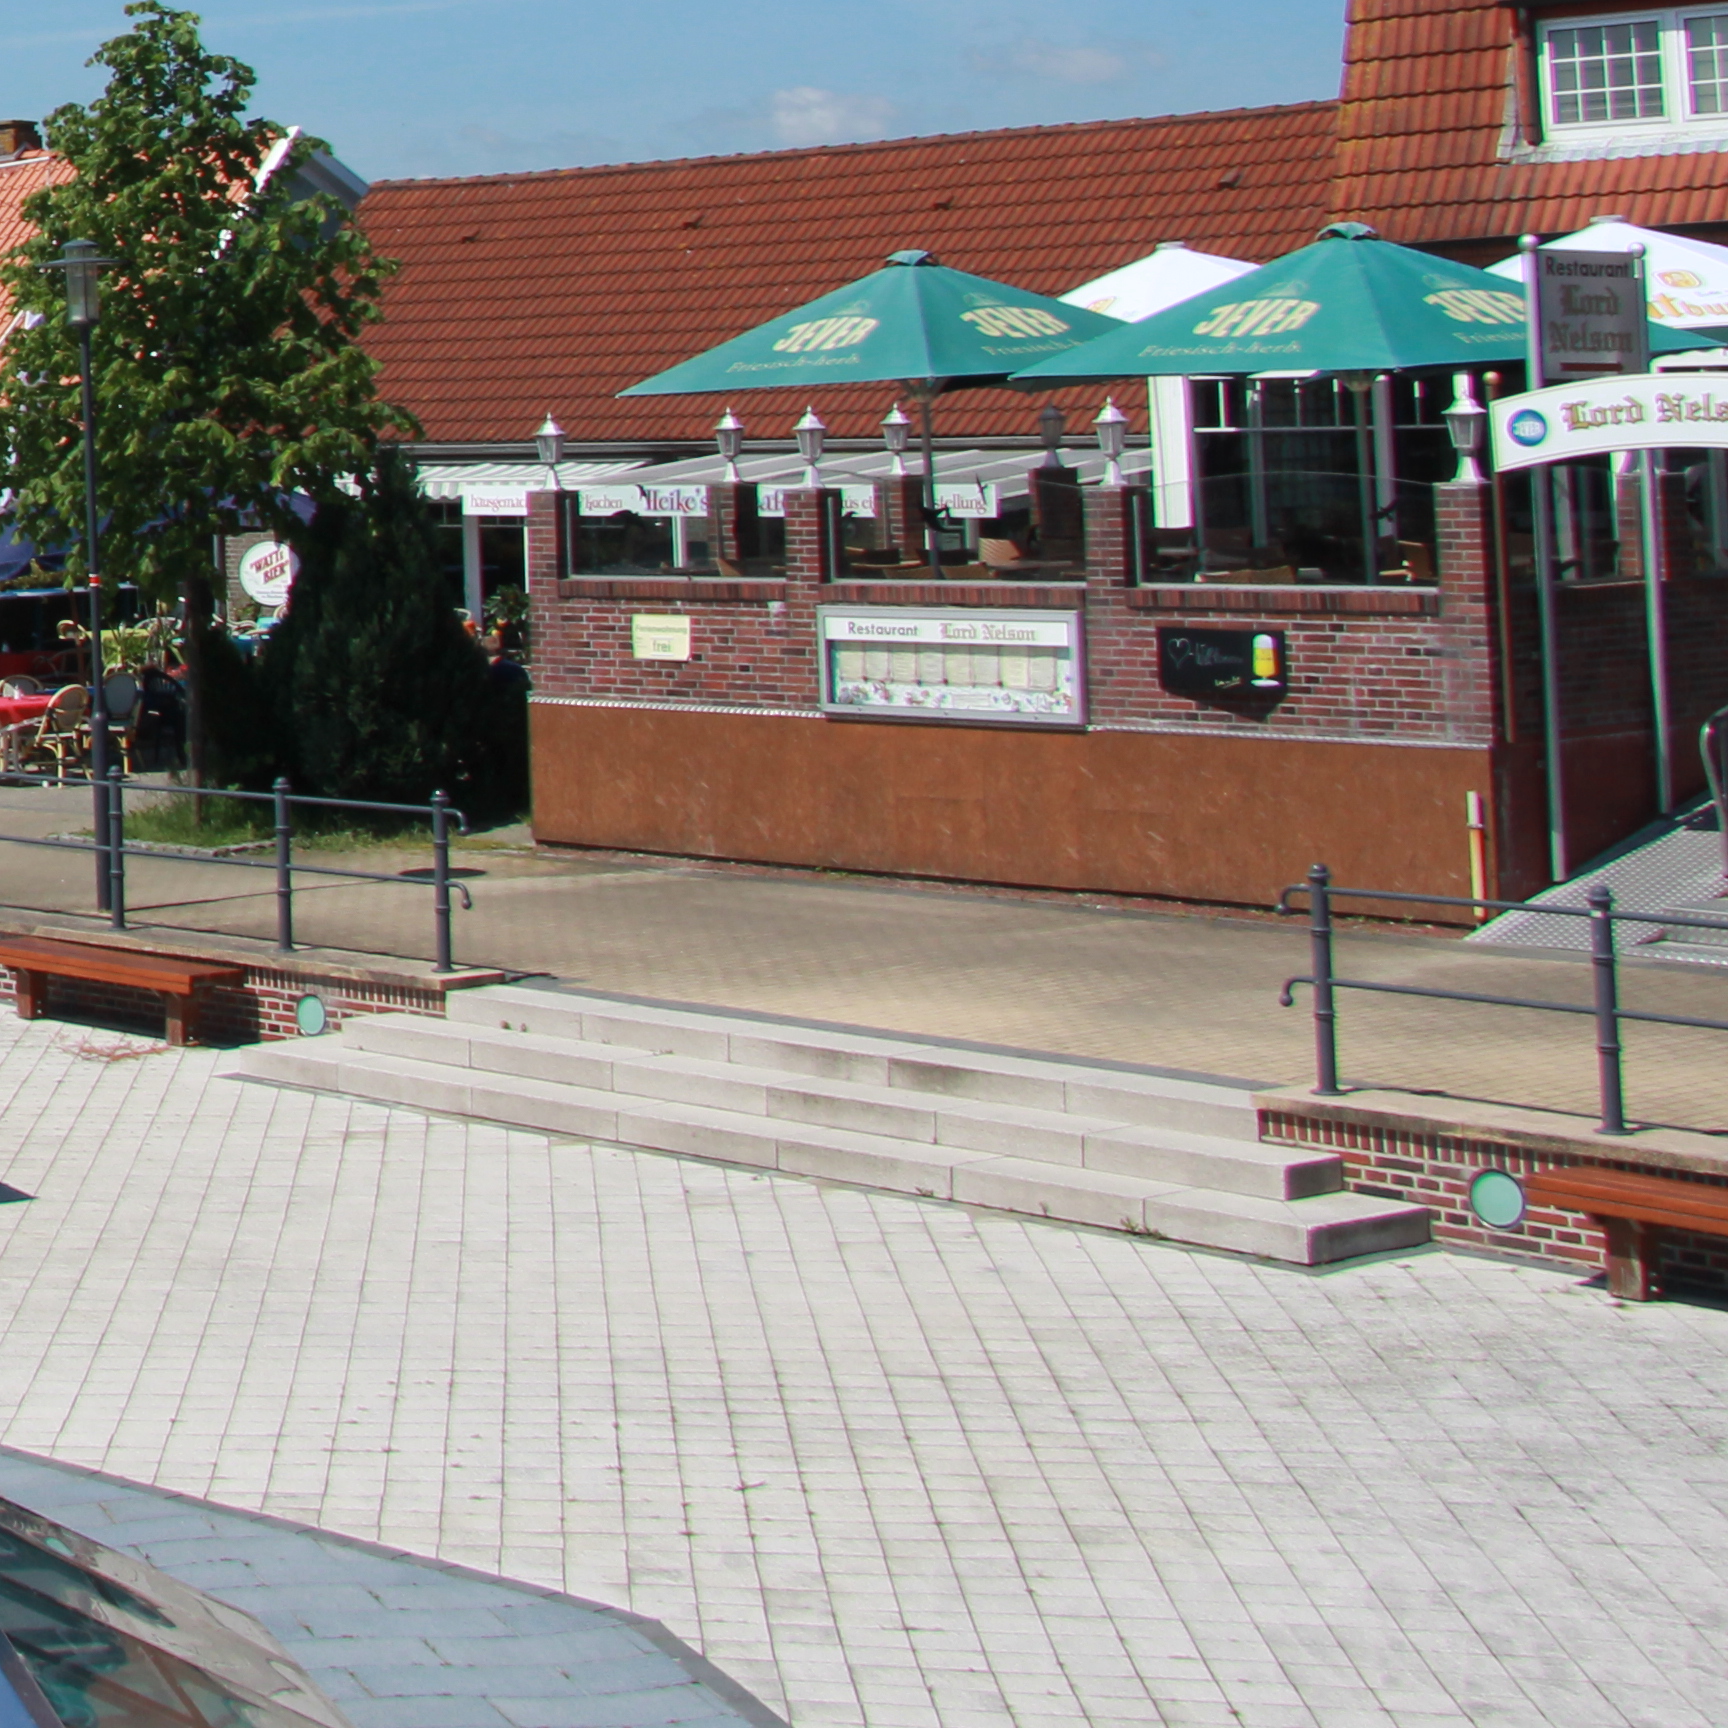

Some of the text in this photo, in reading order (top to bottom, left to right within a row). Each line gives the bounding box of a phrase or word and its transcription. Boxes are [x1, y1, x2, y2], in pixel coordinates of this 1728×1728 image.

[1545, 256, 1629, 278] Restaurant
[1560, 284, 1619, 316] Lord
[959, 306, 1071, 339] JEVER
[1192, 298, 1321, 338] JEVER
[772, 317, 878, 353] JEVER
[1549, 321, 1633, 353] Nelson
[1559, 392, 1728, 432] Lord Nels
[470, 494, 526, 512] hausgemac
[653, 639, 671, 652] frei
[847, 621, 1036, 641] Restaurant Lord Nelson
